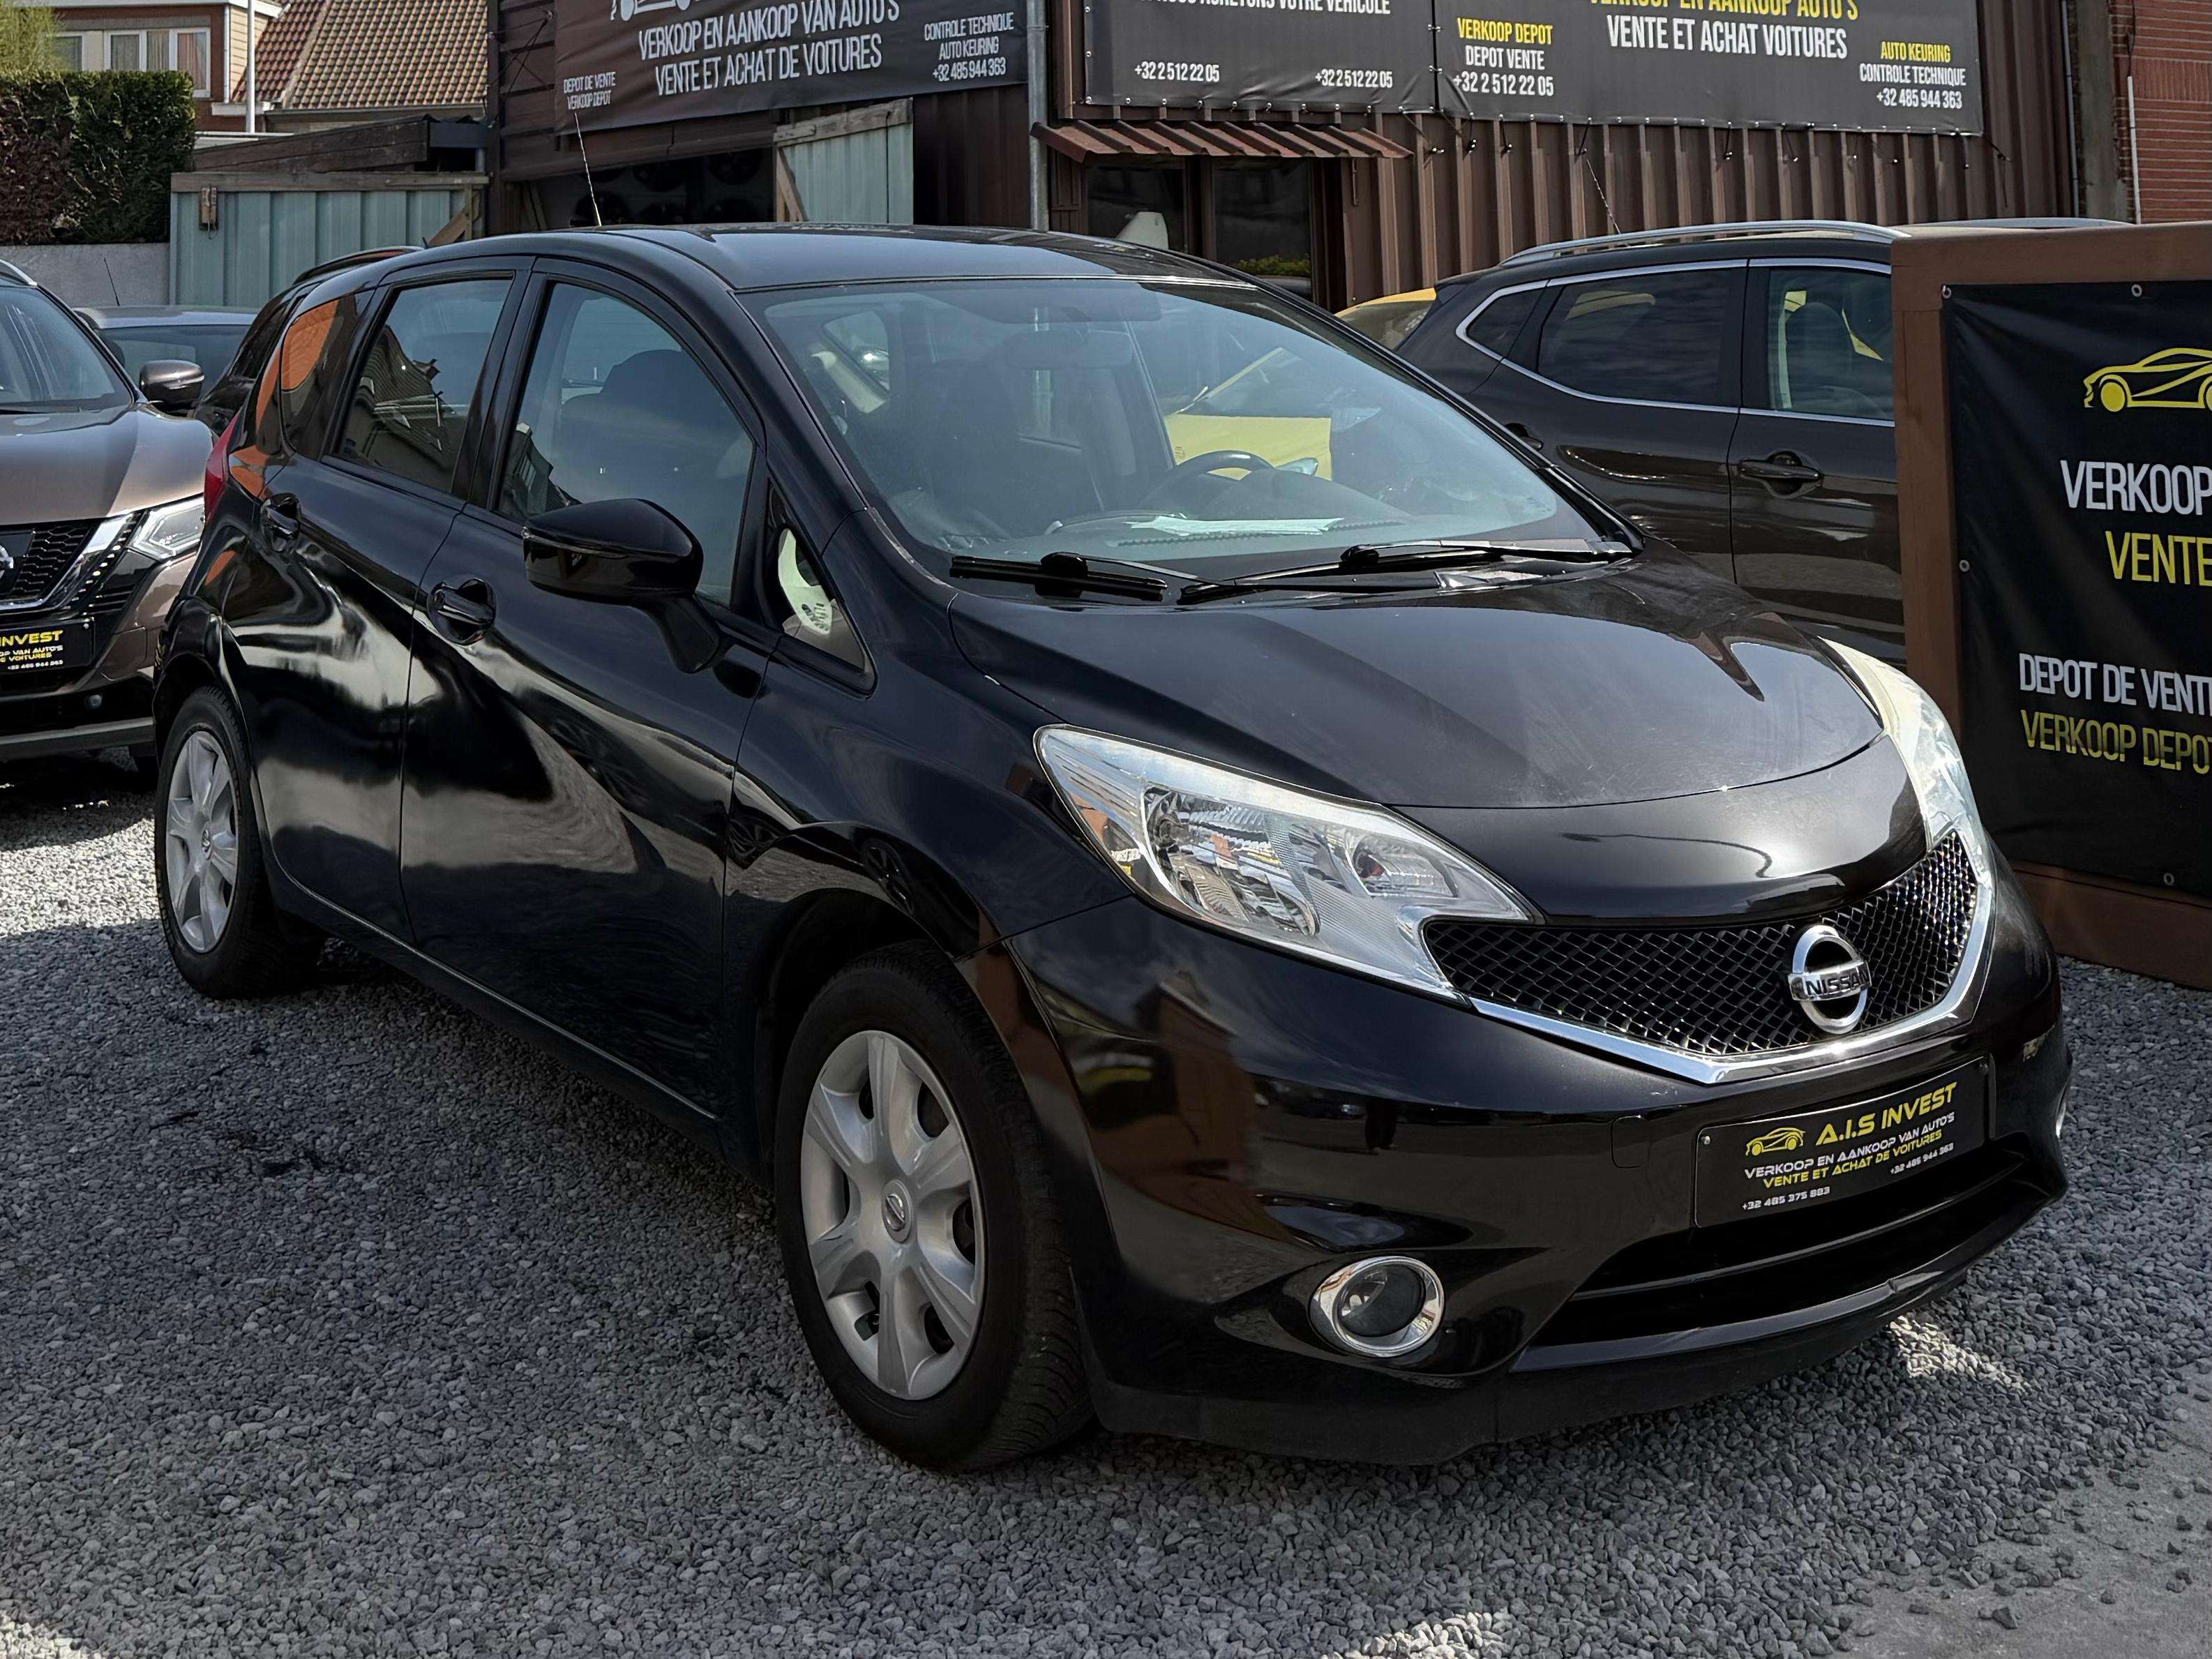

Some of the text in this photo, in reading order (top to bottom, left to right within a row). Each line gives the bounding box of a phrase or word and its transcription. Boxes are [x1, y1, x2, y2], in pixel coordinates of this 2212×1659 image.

[1797, 0, 1858, 20] AUTOS
[639, 0, 899, 60] VERKOOP EN AANKOOP VAN AUTOS
[924, 12, 1014, 40] CONTROLE TECHNIQUE
[1457, 17, 1553, 45] VERKOOP DEPOT
[1607, 15, 1848, 59] VENTE ET ACHAT VOITURES
[939, 36, 999, 60] AUTO KEURING
[1465, 45, 1545, 70] DEPOT VENTE
[1881, 41, 1951, 63] AUTO KEURING
[656, 33, 882, 96] VENTE ET ACHAT DE VOITURES
[933, 57, 1006, 82] +32 485 944 363
[1134, 61, 1220, 82] +32 2 512 22 05
[1860, 63, 1966, 87] CONTROLE TECHNIQUE
[564, 71, 616, 93] DEPOT DE VENTE
[1315, 68, 1334, 87] +32
[1344, 70, 1364, 88] 512
[1365, 70, 1378, 88] 22
[1379, 70, 1393, 89] 05
[1453, 70, 1553, 96] +32 2 512 22 05
[567, 89, 611, 110] VERKOOP DEPOT
[1876, 87, 1963, 110] +32 485 944 363
[2060, 459, 2212, 516] VERKOOP
[2105, 531, 2212, 587] VENTE
[2019, 653, 2212, 716] DEPOT DE VENT
[2021, 710, 2212, 774] VERKOOP DEPO
[1805, 966, 1869, 996] NISSAN
[1816, 1081, 1957, 1146] A.I.S INVEST
[1745, 1111, 1955, 1179] VERKOOP EN AANKOOP VAN AUTO'S
[1763, 1129, 1942, 1189] VENTE ET ACHAT DE VOITURES
[1743, 1200, 1762, 1210] +32
